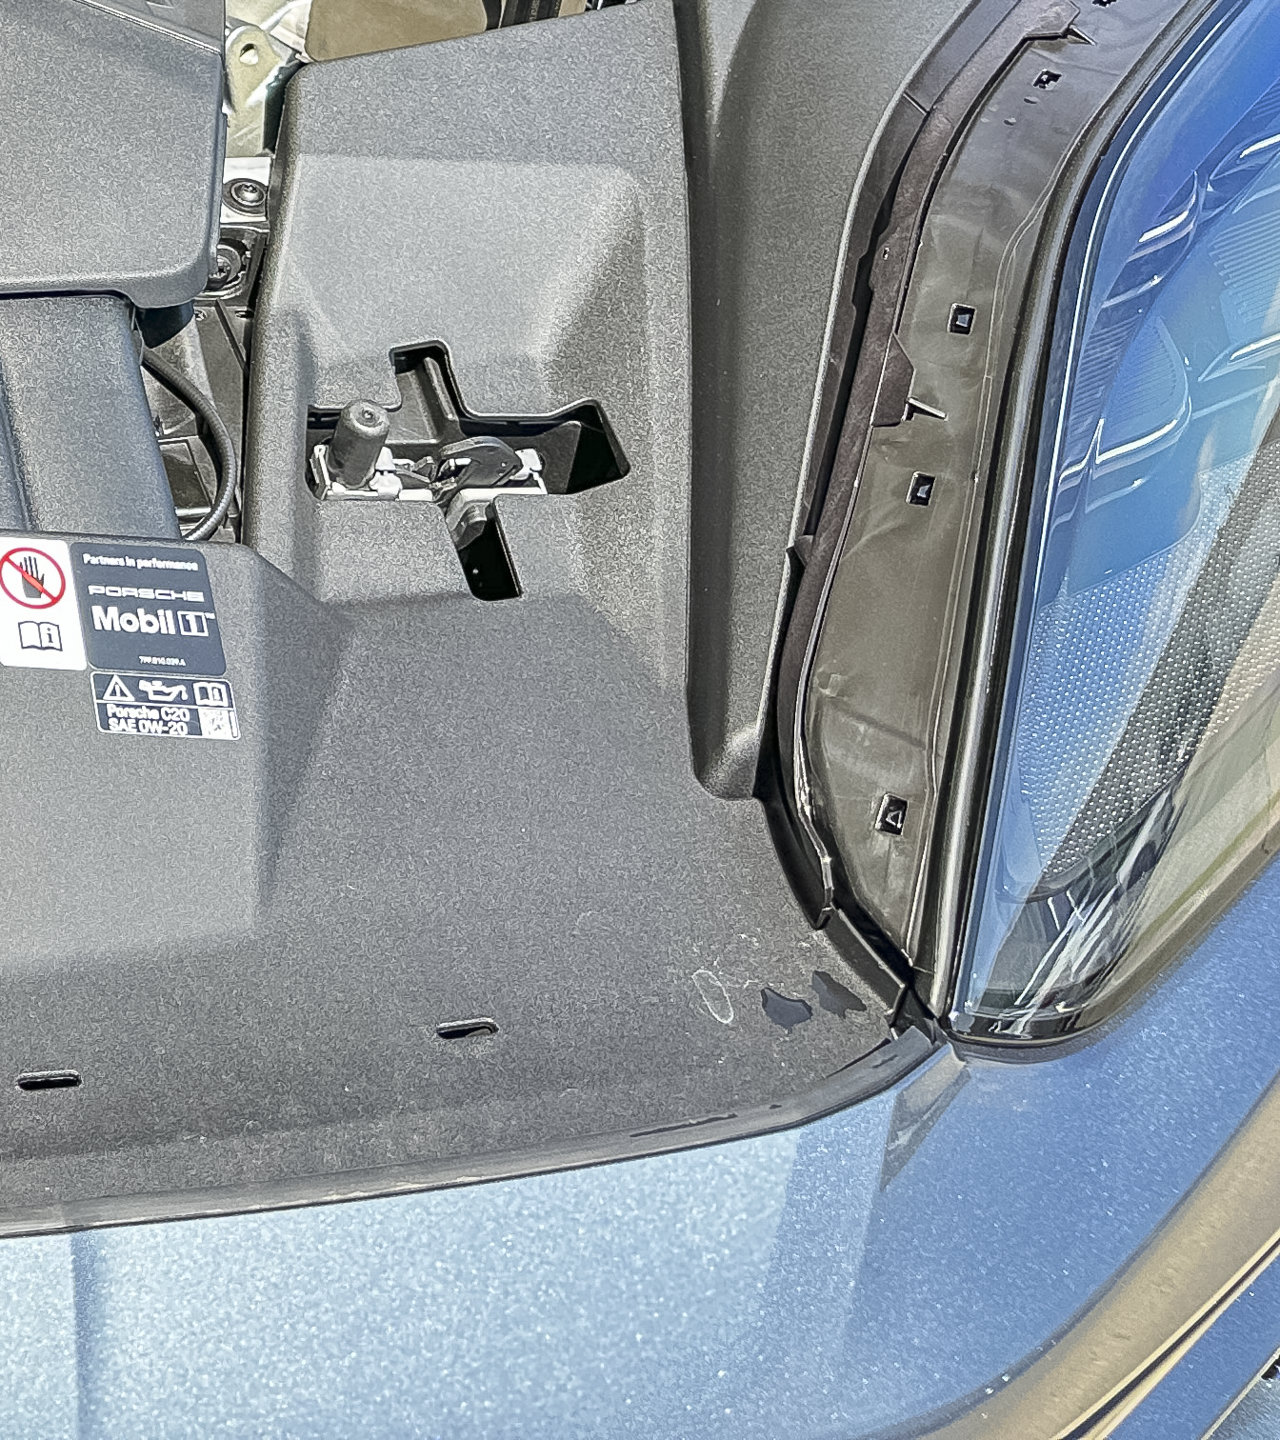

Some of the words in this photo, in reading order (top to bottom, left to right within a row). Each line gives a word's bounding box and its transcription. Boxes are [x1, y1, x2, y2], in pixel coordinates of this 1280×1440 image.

[82, 553, 125, 566] Partners
[125, 556, 135, 567] in
[136, 558, 199, 571] performance
[87, 585, 205, 603] PORSCHE
[91, 605, 176, 635] Mobil
[106, 704, 160, 720] Porsche
[160, 707, 190, 722] C20
[108, 718, 137, 733] SAE
